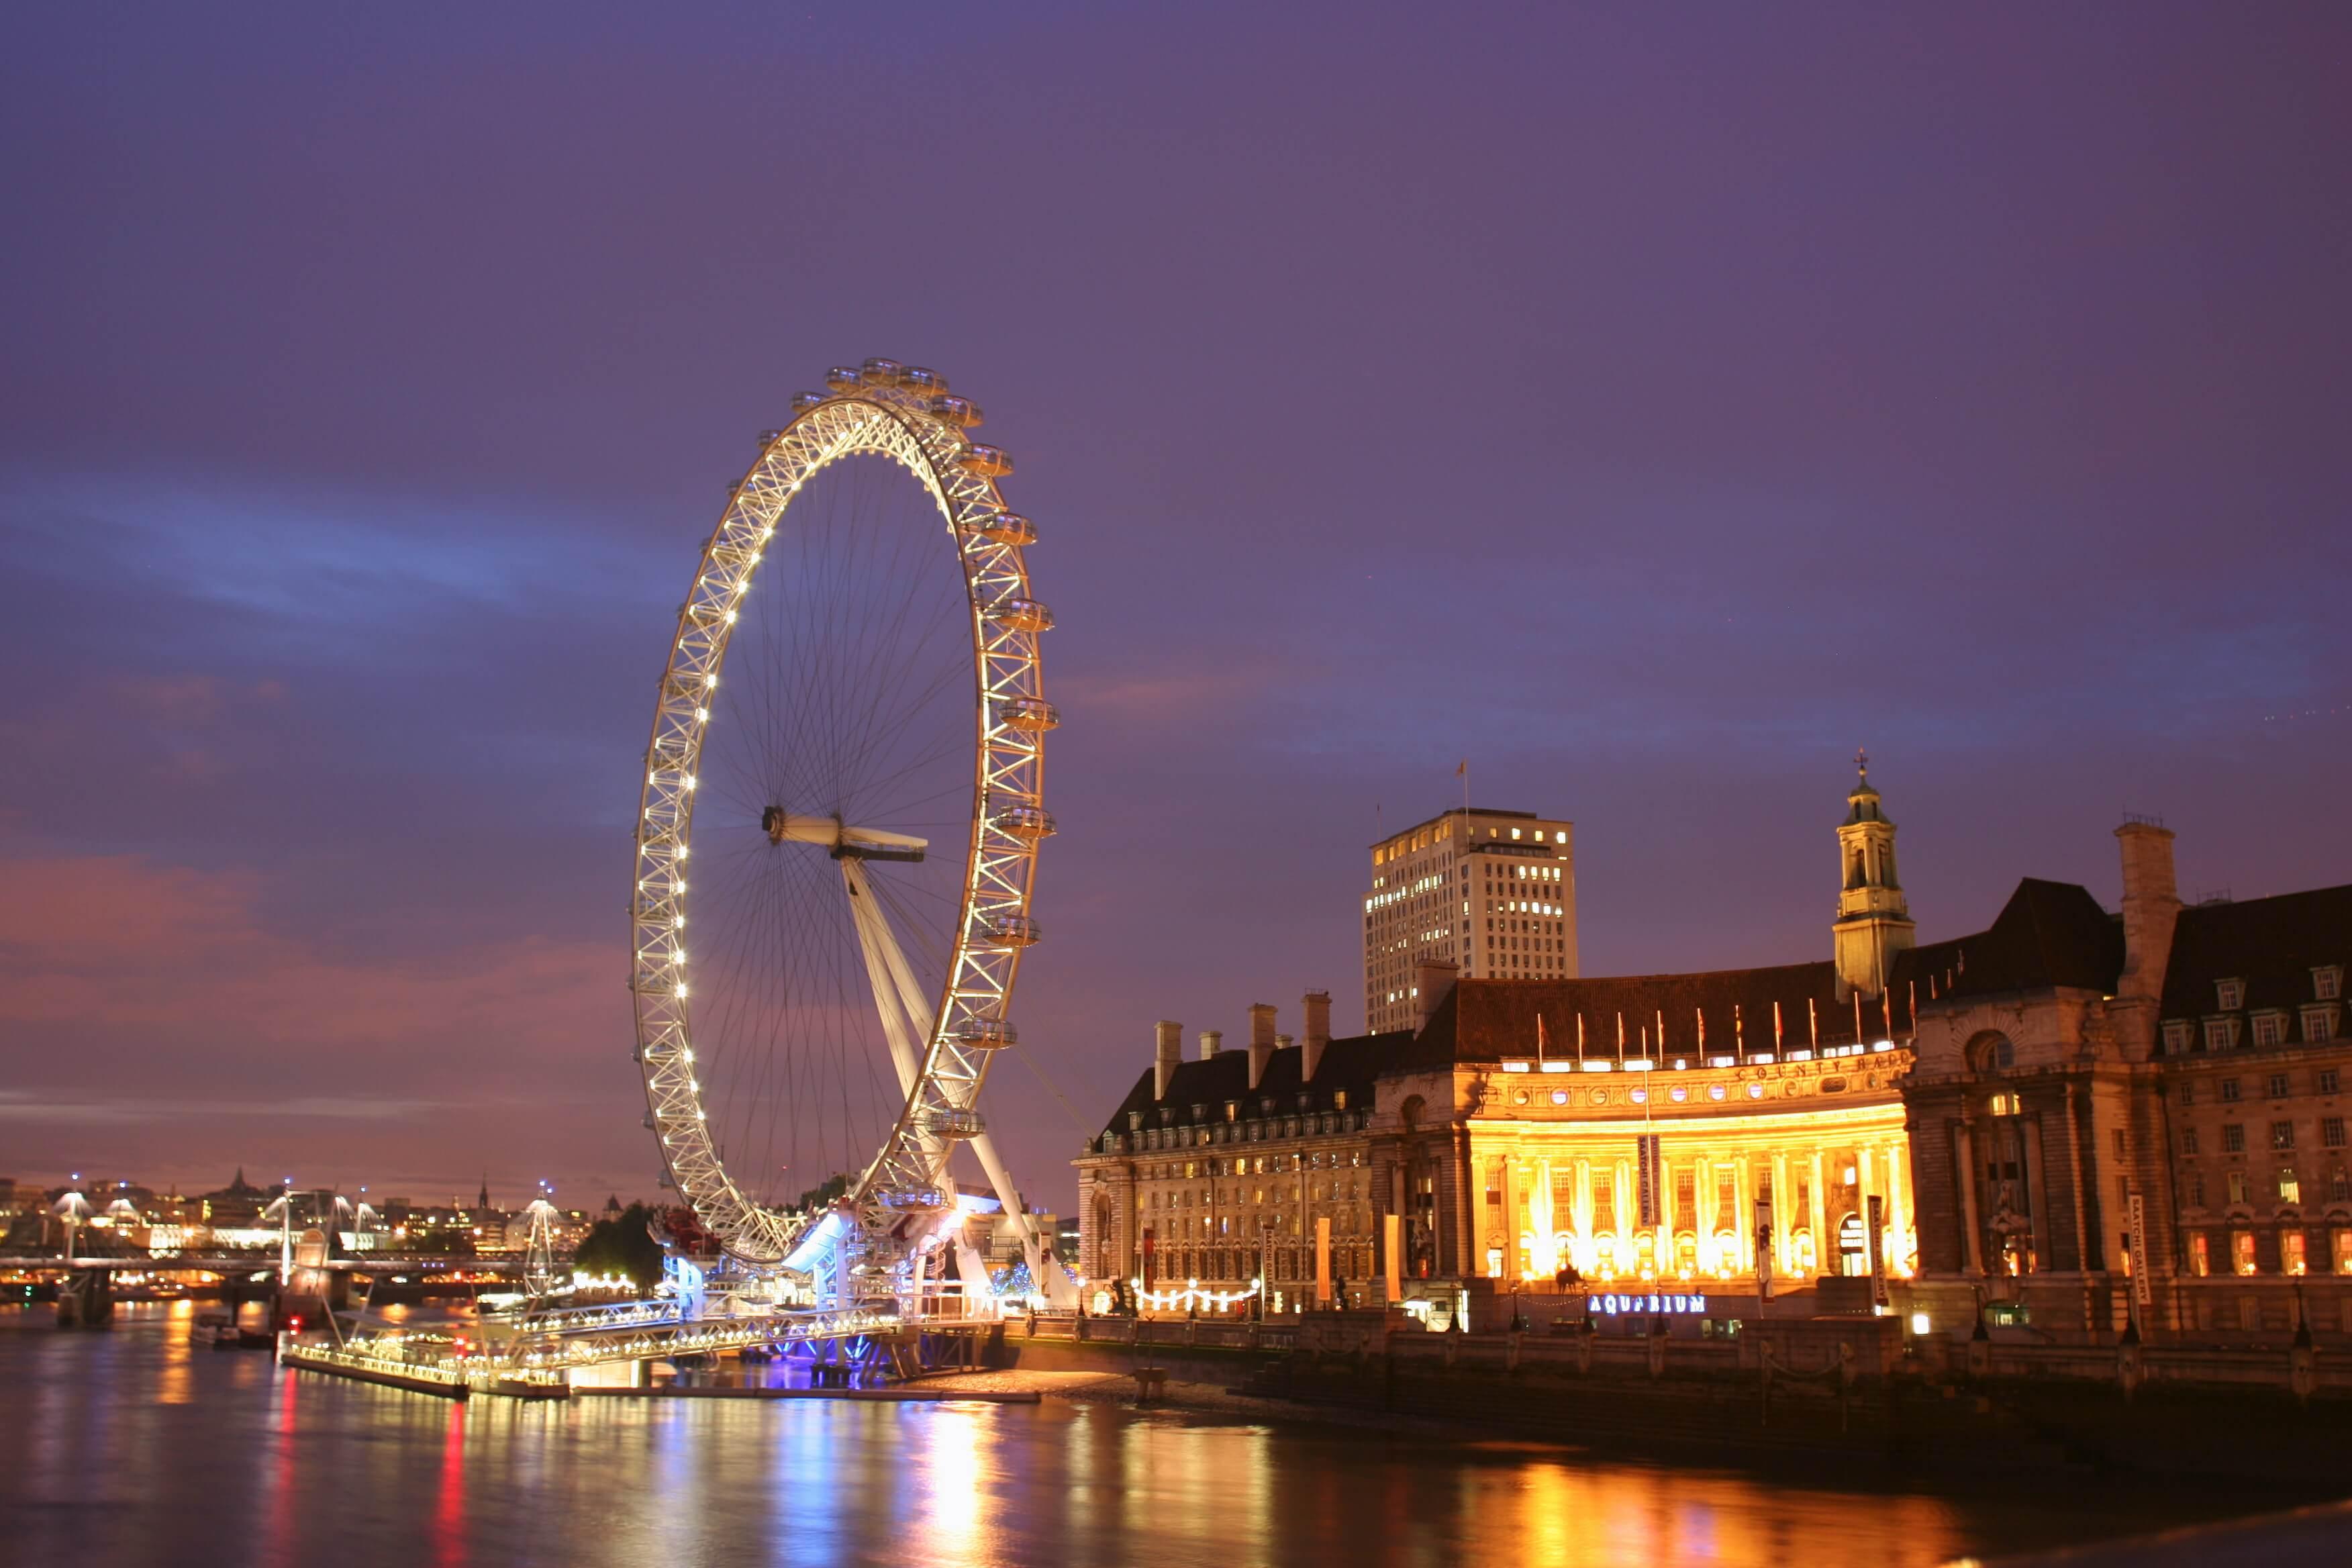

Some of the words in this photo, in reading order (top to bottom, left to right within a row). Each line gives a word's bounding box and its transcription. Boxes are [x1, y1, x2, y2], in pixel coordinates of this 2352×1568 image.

[1640, 1137, 1648, 1177] SAATCHI
[1873, 1202, 1881, 1246] SAATCHI
[2133, 1198, 2141, 1246] SAATCHI
[1876, 1251, 1885, 1298] GALLERY
[2135, 1251, 2147, 1300] GALLERY
[1589, 1295, 1706, 1314] AQUARIUM
